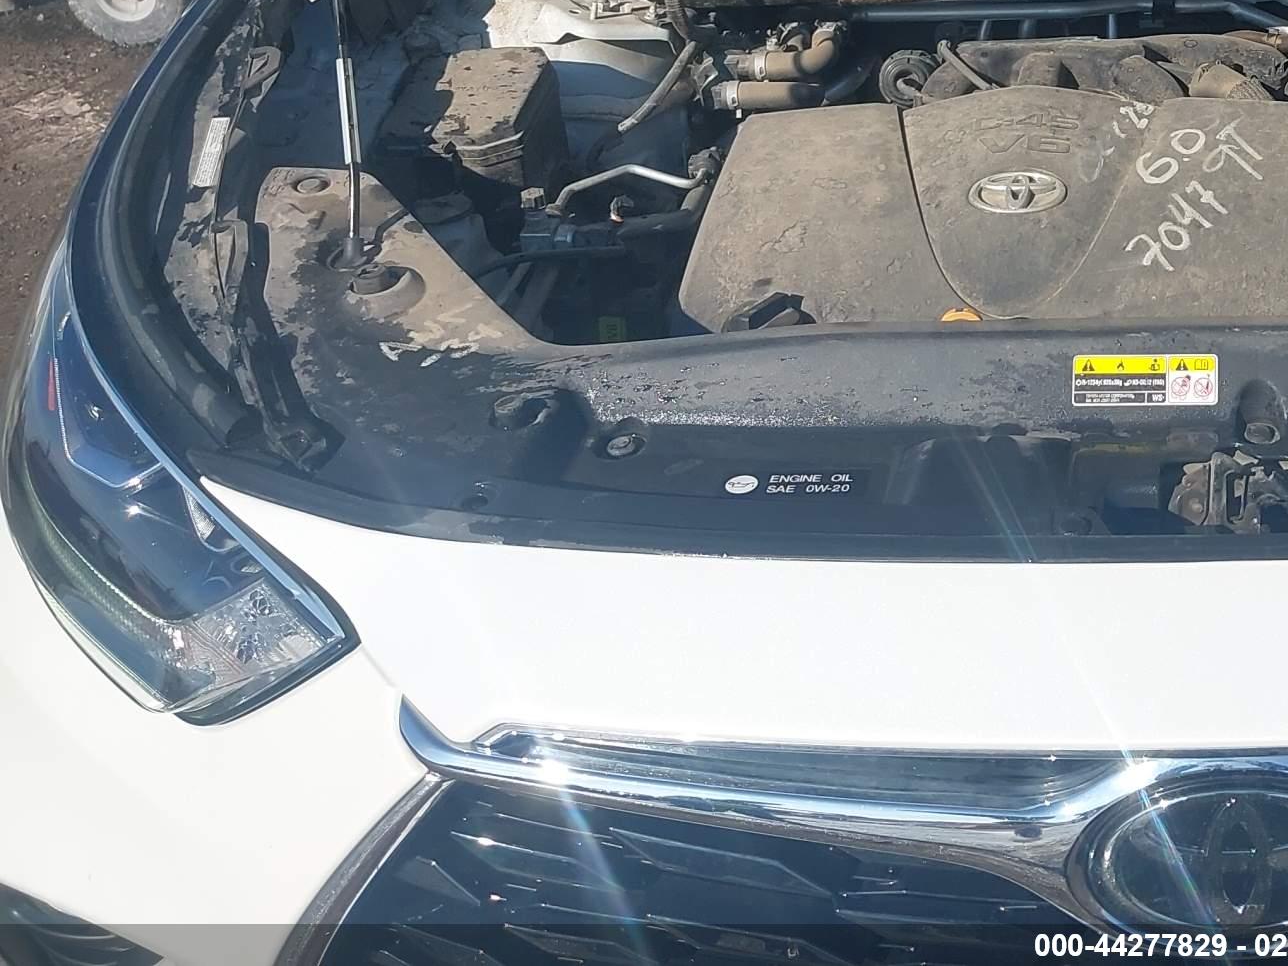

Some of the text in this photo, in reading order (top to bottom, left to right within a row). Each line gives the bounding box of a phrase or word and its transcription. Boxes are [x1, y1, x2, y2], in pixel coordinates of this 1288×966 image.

[979, 133, 1071, 154] V6
[769, 474, 853, 483] ENGINE OIL
[766, 484, 850, 493] SAE 0W-20
